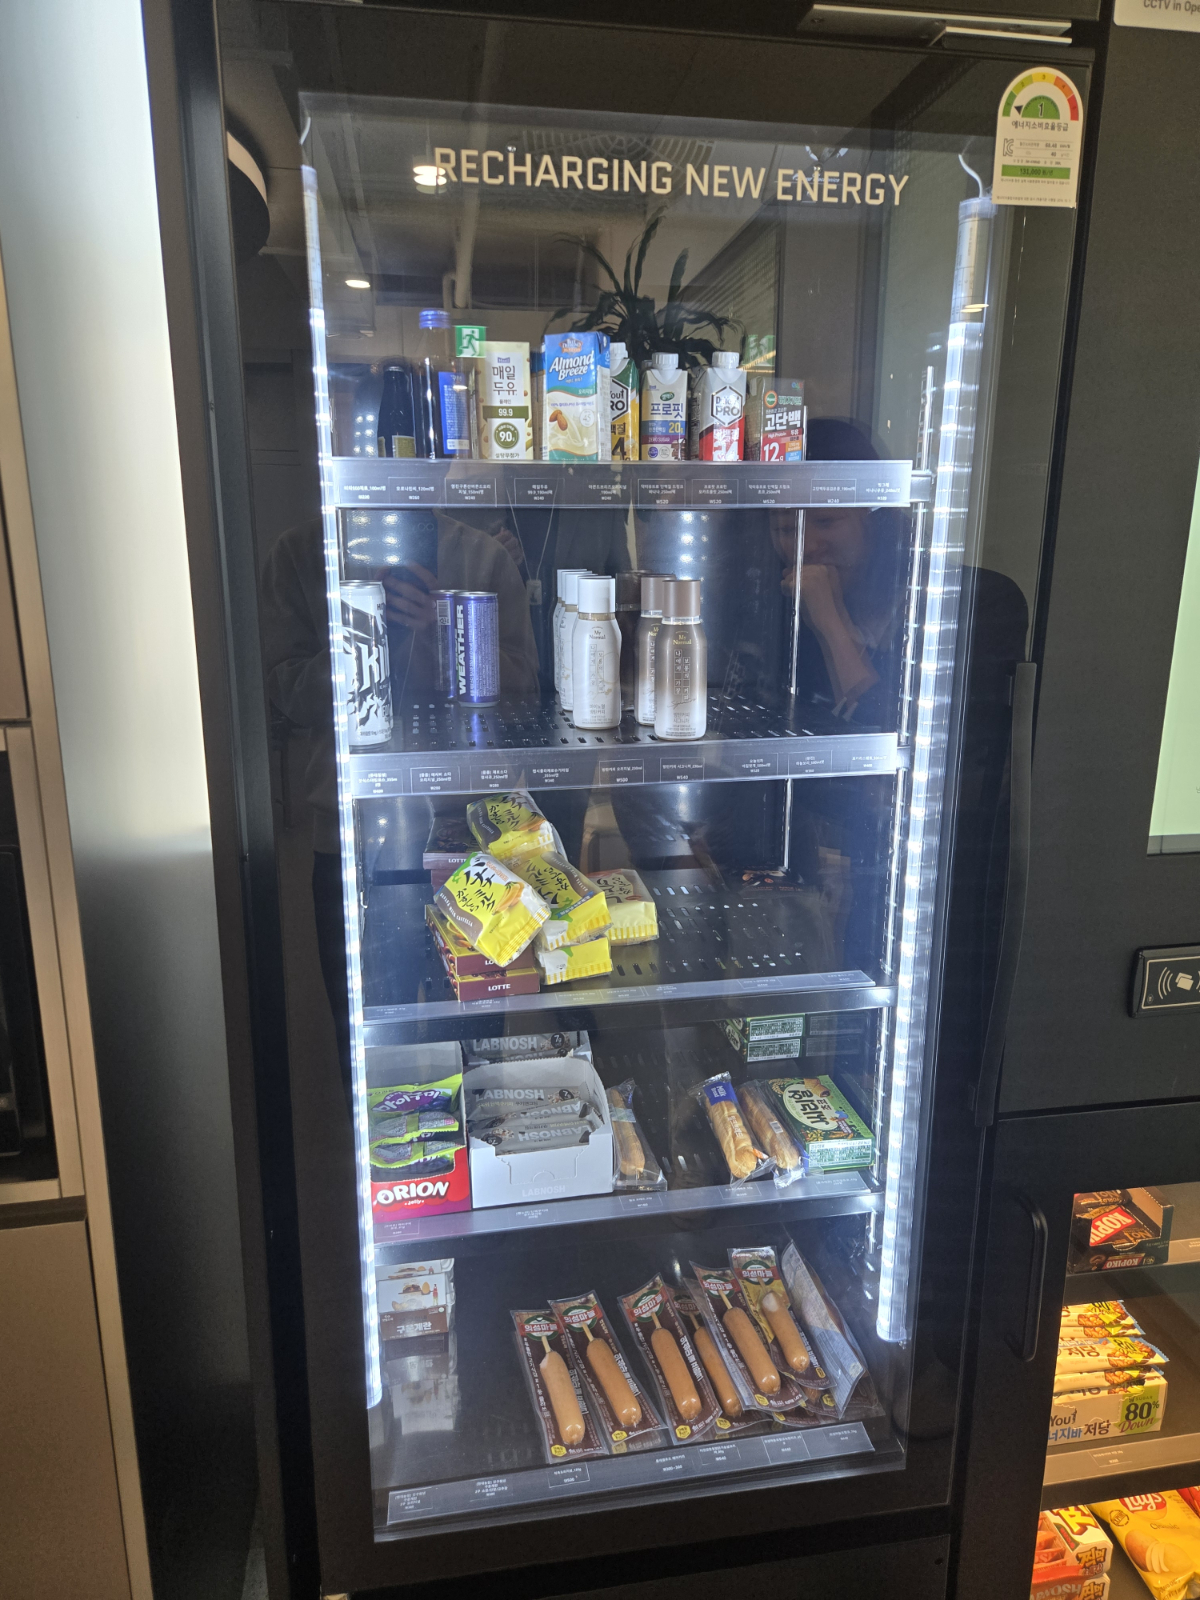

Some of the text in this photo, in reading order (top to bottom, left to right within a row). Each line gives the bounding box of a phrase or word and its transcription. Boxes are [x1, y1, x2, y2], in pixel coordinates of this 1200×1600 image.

[1143, 0, 1170, 10] CCTV
[1173, 1, 1181, 11] in
[1038, 102, 1044, 117] 1
[1011, 120, 1069, 132] 에너지소비효율등급
[434, 147, 909, 206] RECHARGING NEW ENERGY
[549, 350, 595, 373] Almond
[492, 365, 516, 380] 매일
[558, 365, 589, 381] Breeze
[492, 382, 518, 397] 두유
[498, 408, 513, 417] 99.9
[610, 400, 626, 411] RO
[650, 403, 684, 419] 프로핏
[715, 405, 740, 416] PRO
[764, 410, 801, 431] 고단백
[456, 605, 467, 695] WEATHER
[475, 888, 496, 913] ミルク
[488, 983, 511, 992] LOTTE
[473, 1036, 538, 1051] LABNOSH
[372, 1089, 442, 1112] 마이구미
[475, 1089, 545, 1101] LABNOSH
[520, 1101, 582, 1118] ABNOSH
[788, 1089, 831, 1128] 씨리얼
[375, 1181, 450, 1205] ORION
[522, 1185, 566, 1197] LABNOSH
[1090, 1211, 1134, 1244] KOPI
[1106, 1257, 1140, 1268] KOPIKO
[742, 1269, 774, 1279] 의성마늘
[633, 1292, 664, 1317] 의성마늘
[563, 1309, 596, 1324] 의성마늘
[396, 1321, 432, 1334] 구운계란
[524, 1322, 558, 1333] 의성마늘
[1068, 1345, 1101, 1357] 저당
[1125, 1400, 1160, 1421] 80%
[1047, 1420, 1111, 1441] 너지바 저당
[1119, 1417, 1154, 1434] Down
[1123, 1492, 1163, 1511] Lays
